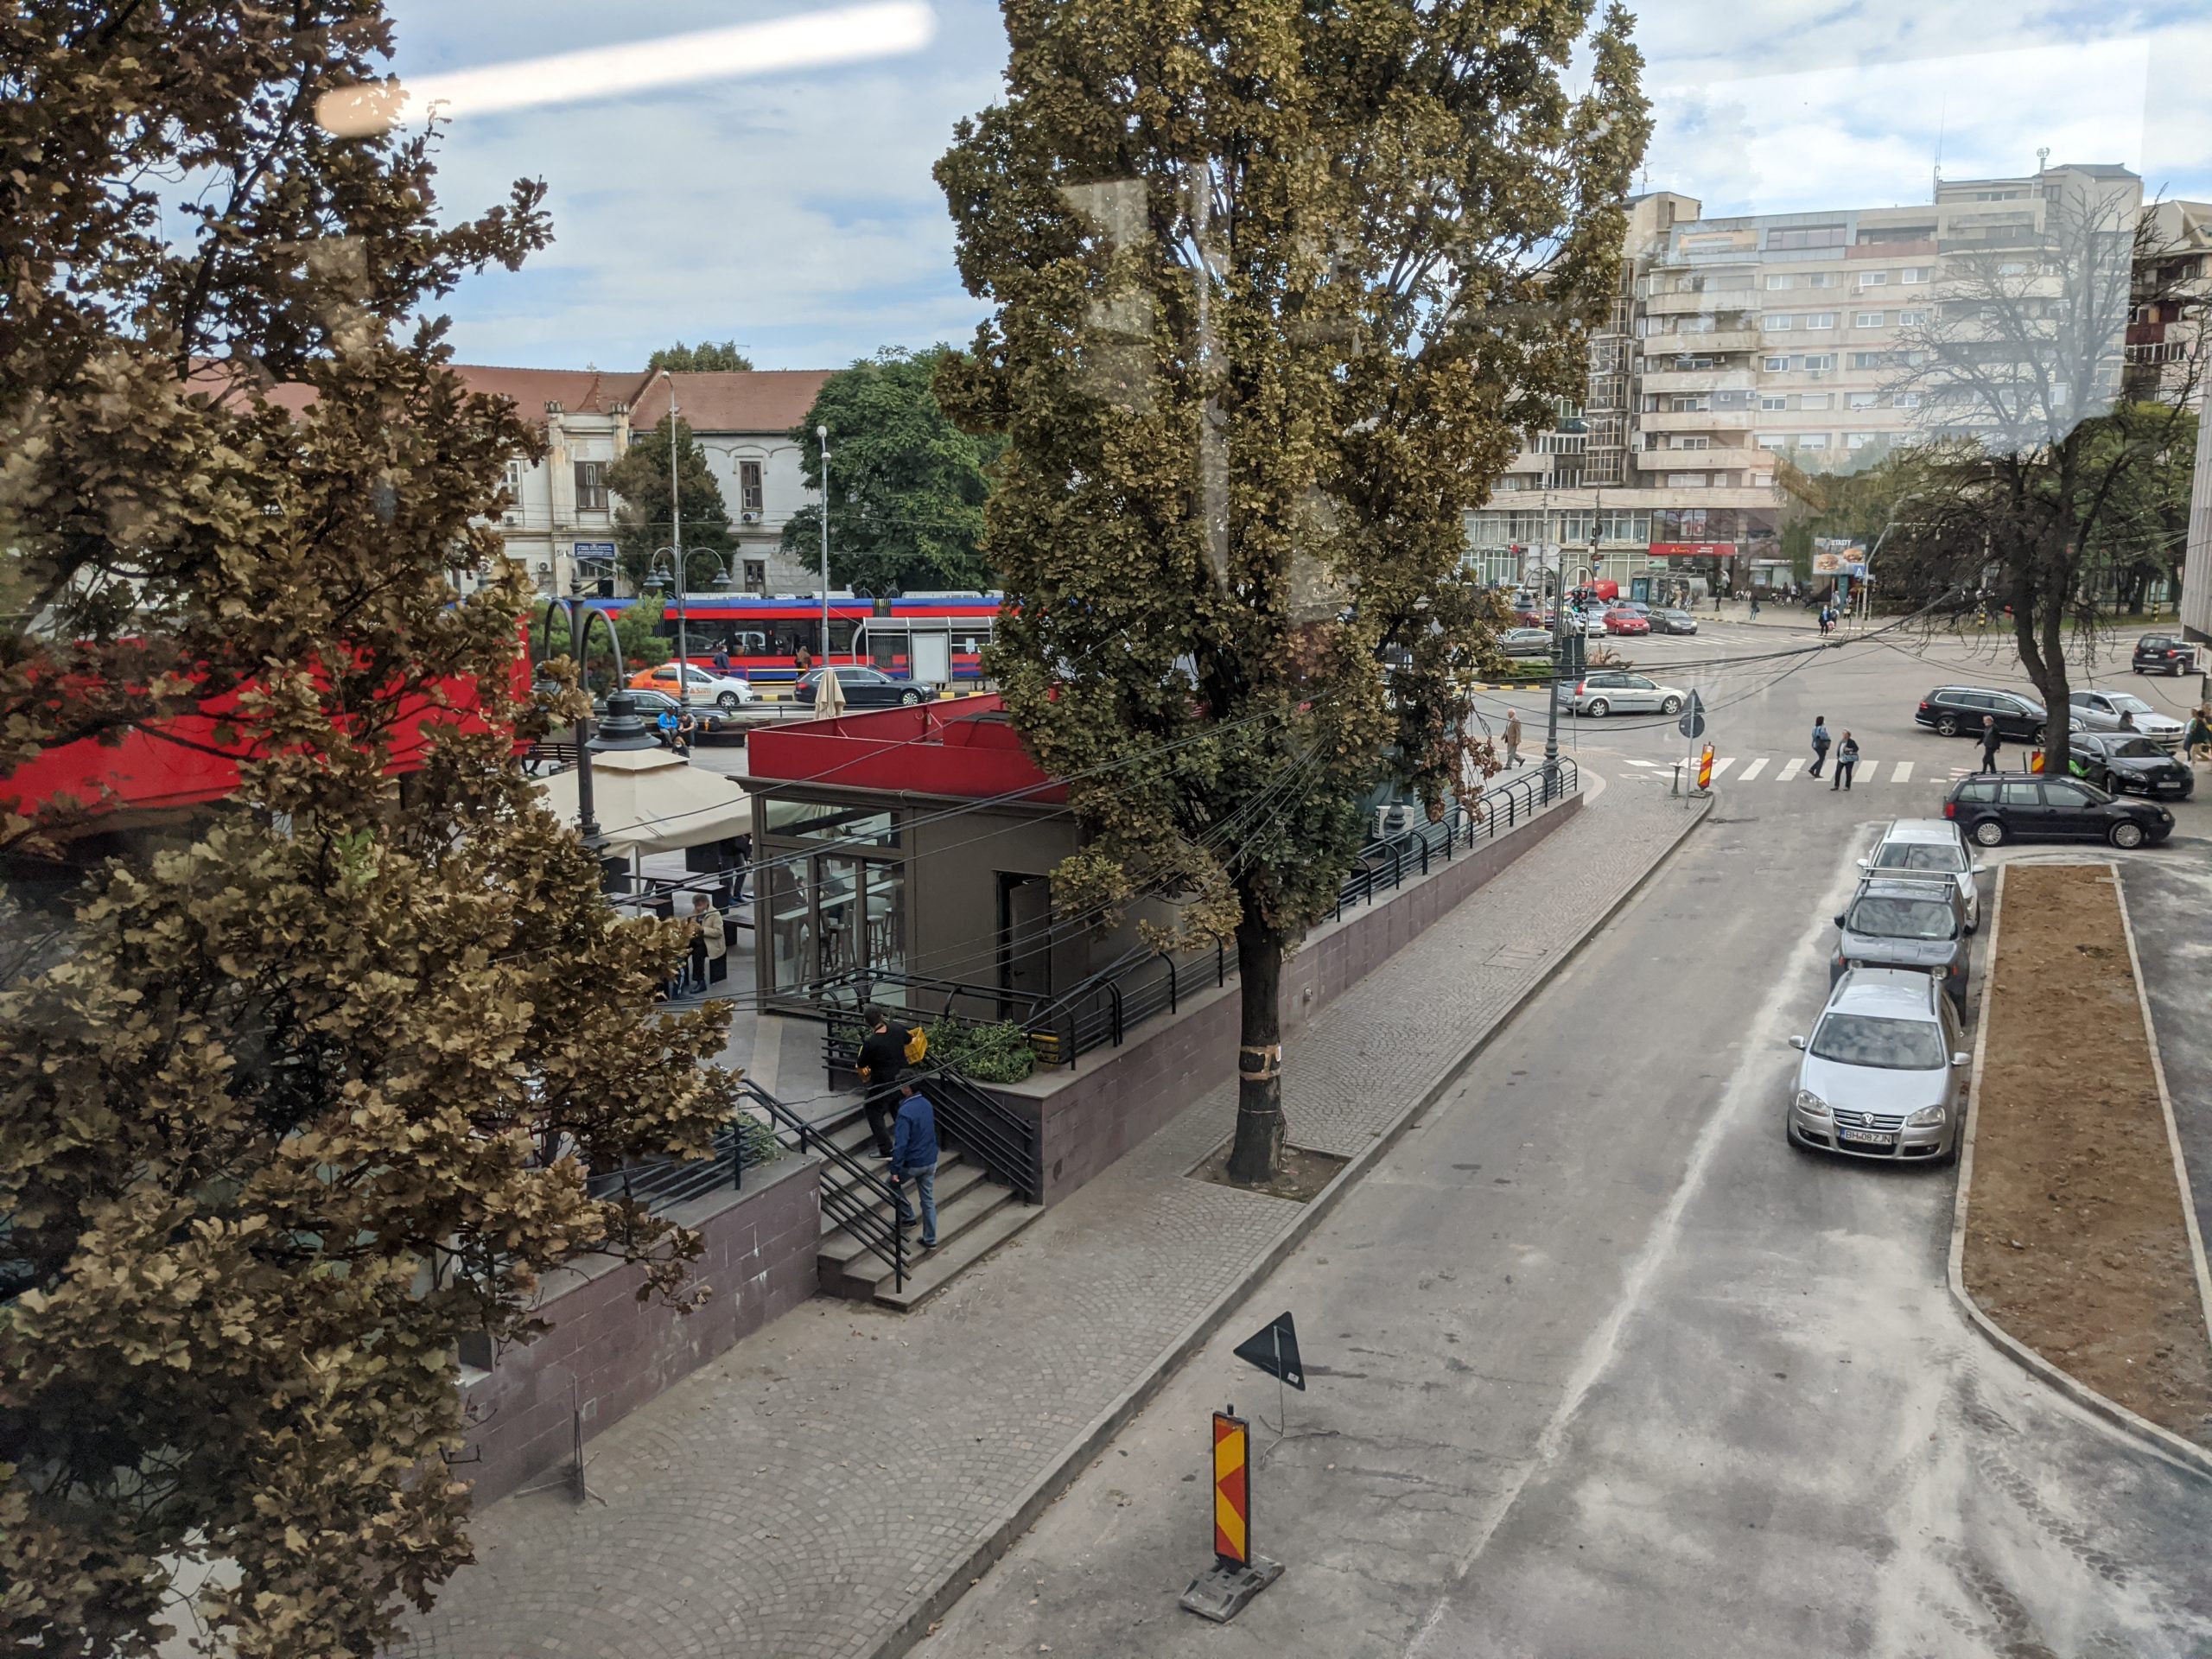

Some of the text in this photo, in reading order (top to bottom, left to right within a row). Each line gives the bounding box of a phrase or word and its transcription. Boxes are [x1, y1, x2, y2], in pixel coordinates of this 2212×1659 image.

[1845, 1130, 1891, 1143] BH 08 ZJN
